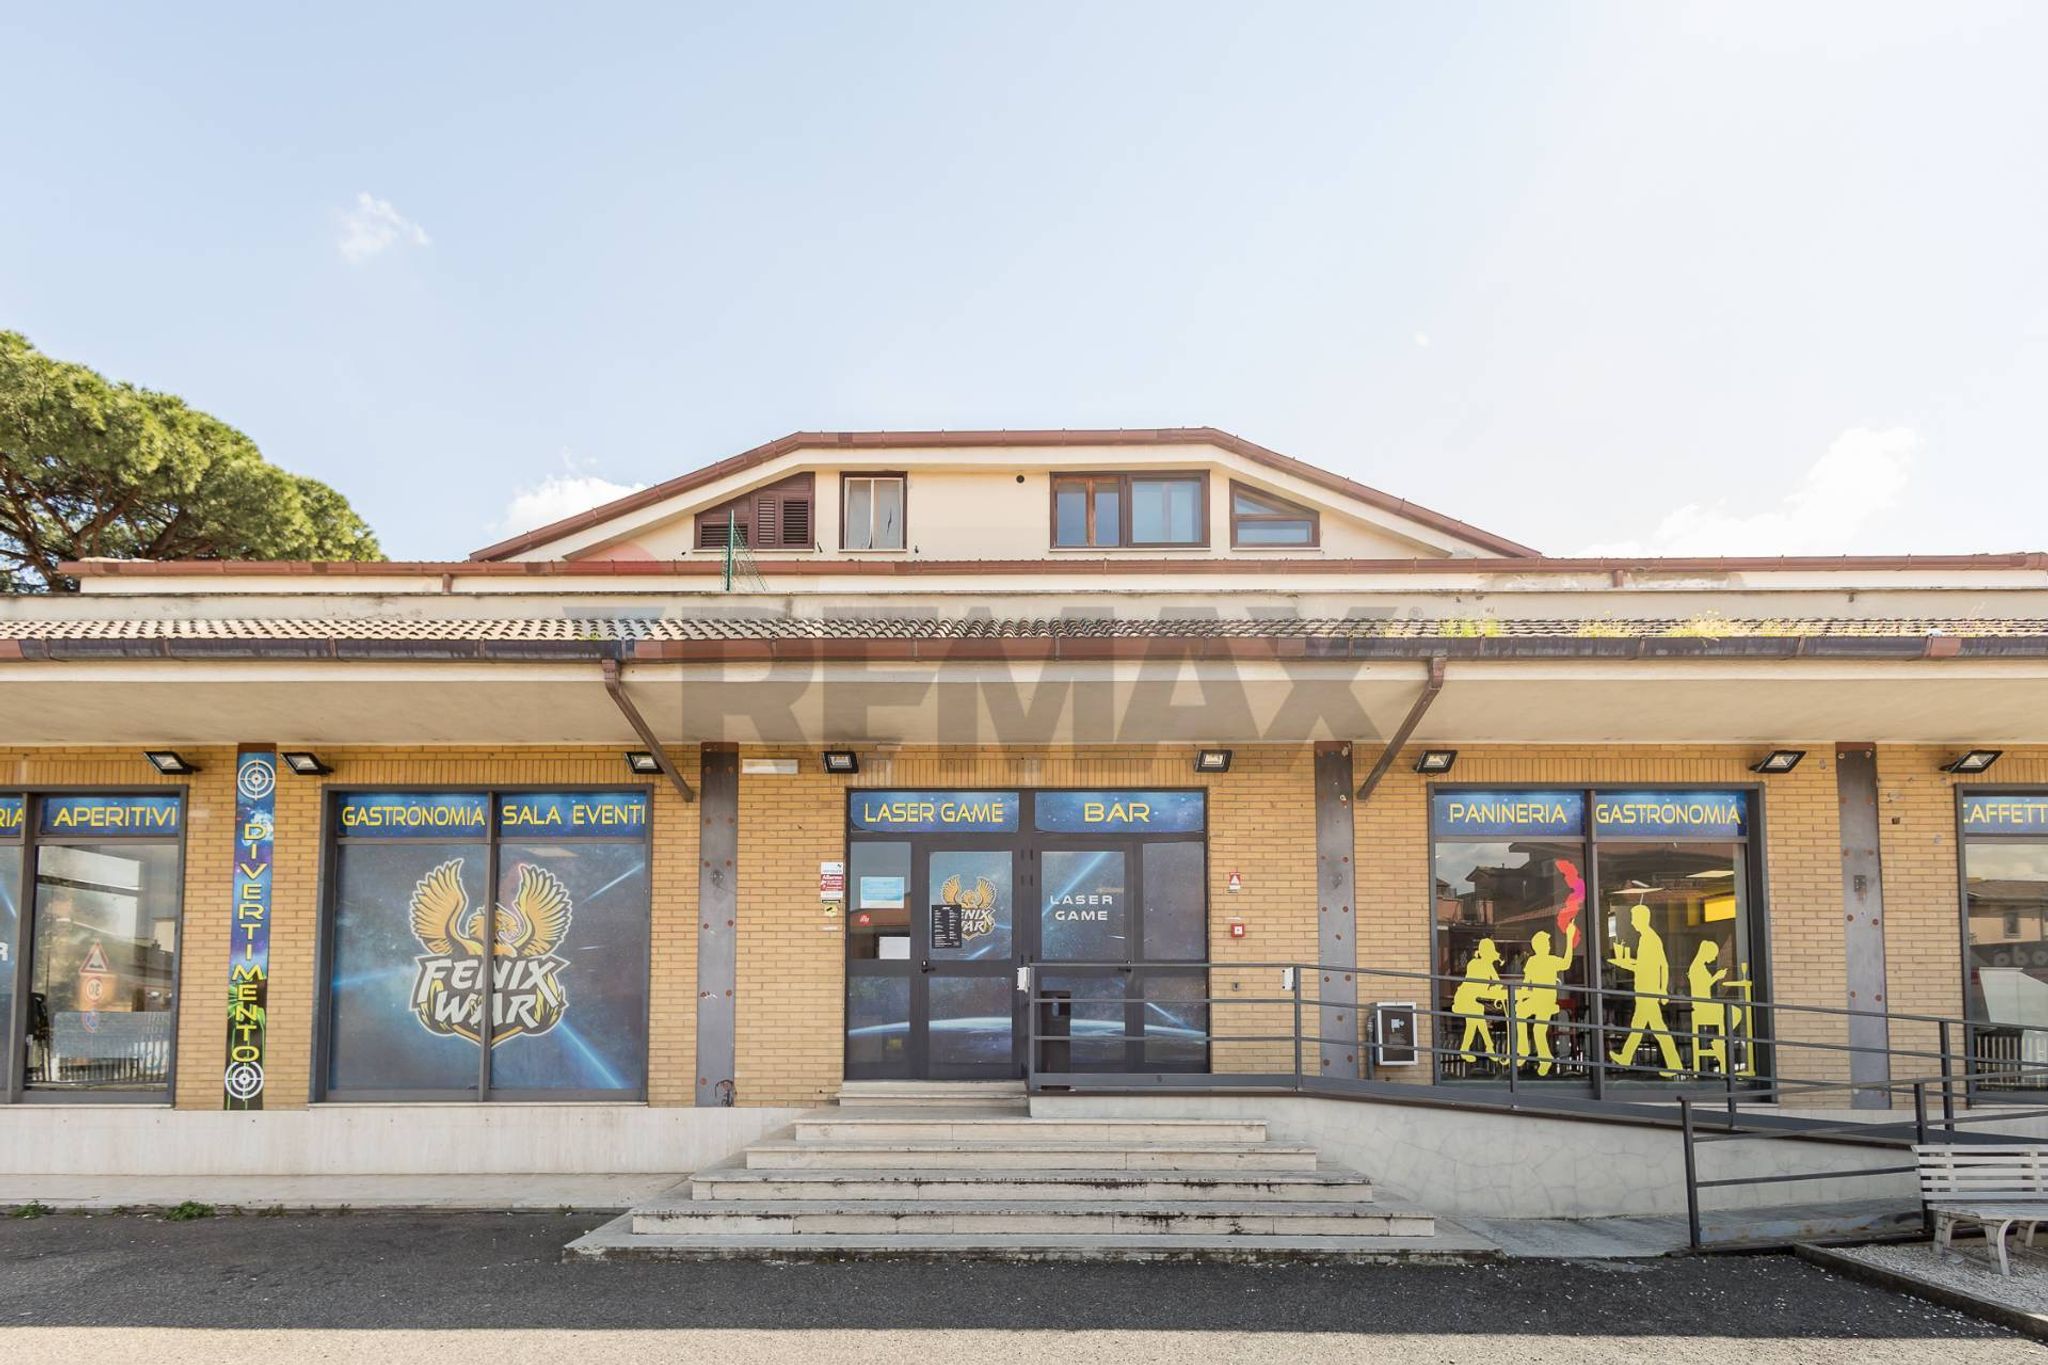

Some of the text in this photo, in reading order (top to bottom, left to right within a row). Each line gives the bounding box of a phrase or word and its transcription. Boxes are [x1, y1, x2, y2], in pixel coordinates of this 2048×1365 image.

[54, 807, 176, 827] APERITIVI
[342, 806, 485, 826] GASTRONOMIA
[502, 805, 646, 825] SALA EVENTI
[864, 803, 1004, 822] LASER GAME
[1084, 803, 1150, 822] BAR
[1449, 804, 1567, 823] PANINERIA
[1596, 804, 1741, 824] GASTRONOMIA
[1050, 895, 1113, 905] LASER
[961, 909, 992, 925] NIX
[1055, 911, 1108, 920] GAME
[231, 824, 267, 1062] DIVERTIMENTO
[417, 959, 559, 1008] FENIX
[434, 991, 539, 1028] WAR
